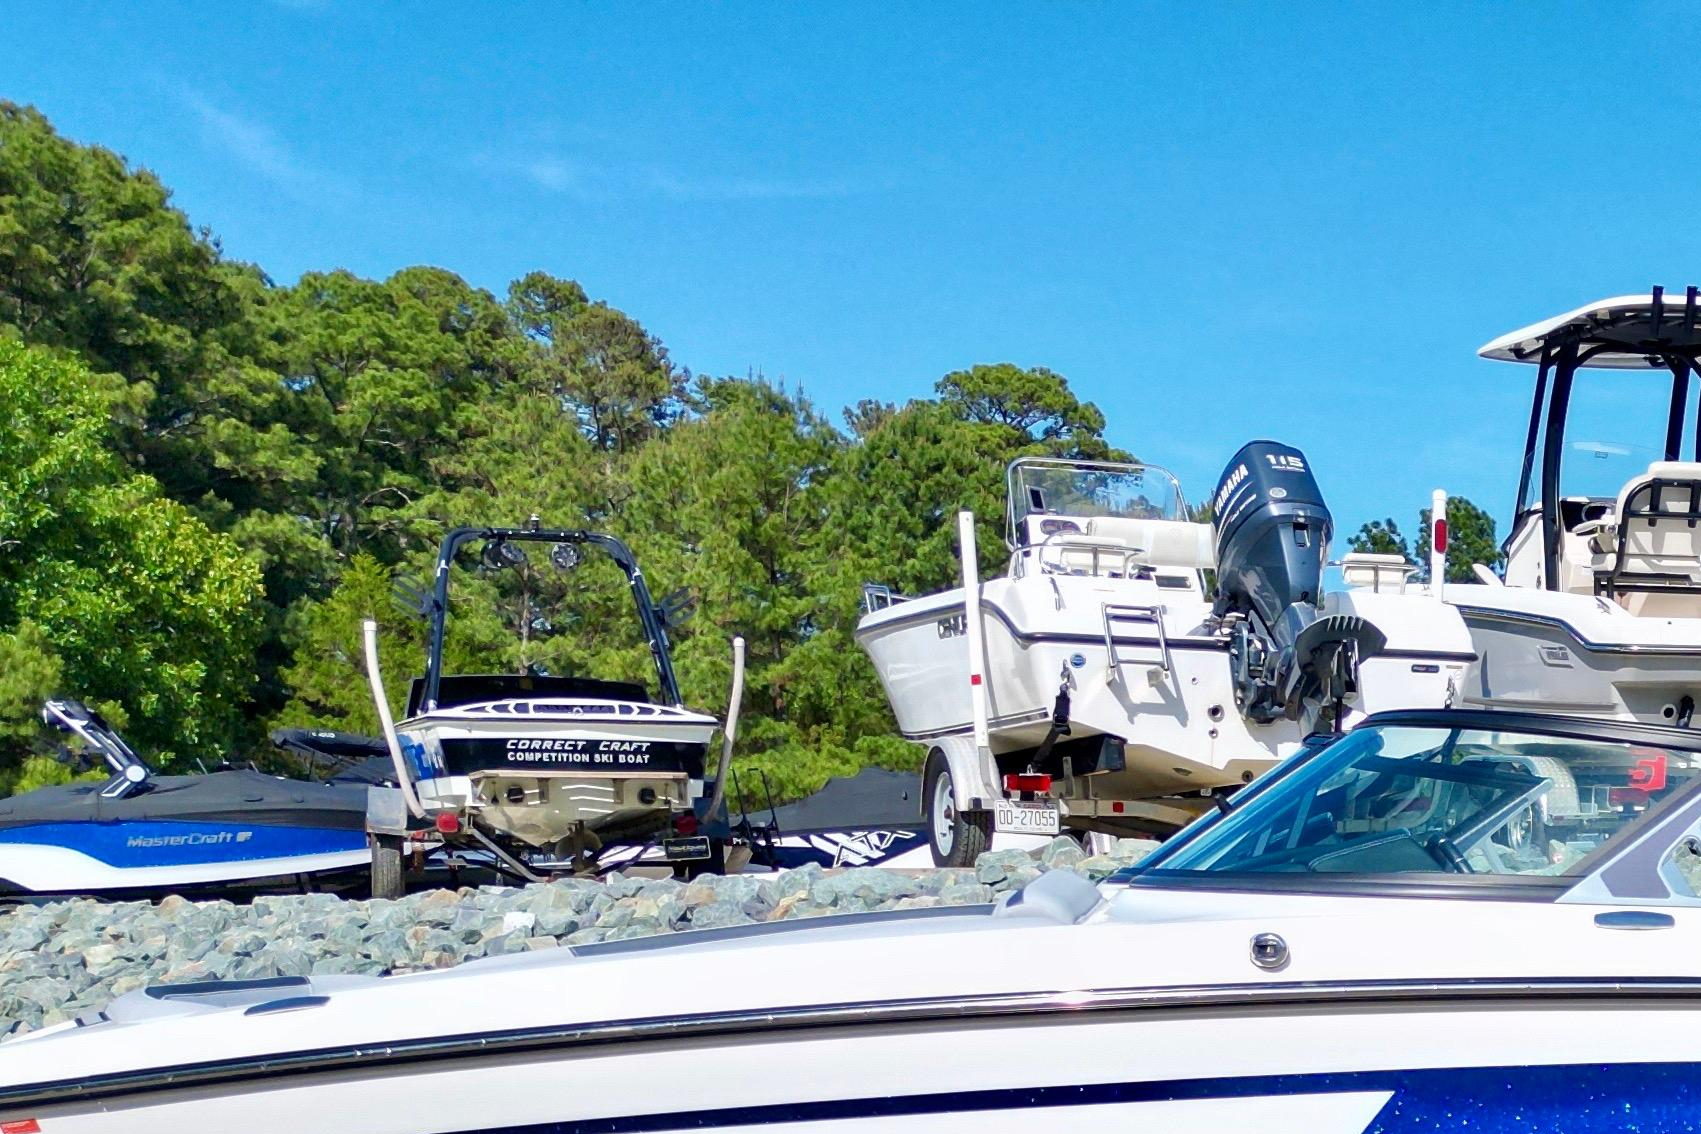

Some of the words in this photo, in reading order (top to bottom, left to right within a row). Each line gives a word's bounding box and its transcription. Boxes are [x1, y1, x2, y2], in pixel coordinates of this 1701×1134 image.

[1265, 454, 1304, 468] 115
[1214, 463, 1249, 517] YAMAHA
[506, 739, 587, 751] CORRECT
[598, 740, 651, 752] CRAFT
[507, 751, 588, 763] COMPETITION
[594, 753, 613, 763] SKI
[618, 753, 650, 764] BOAT
[126, 831, 234, 848] MasterCraft
